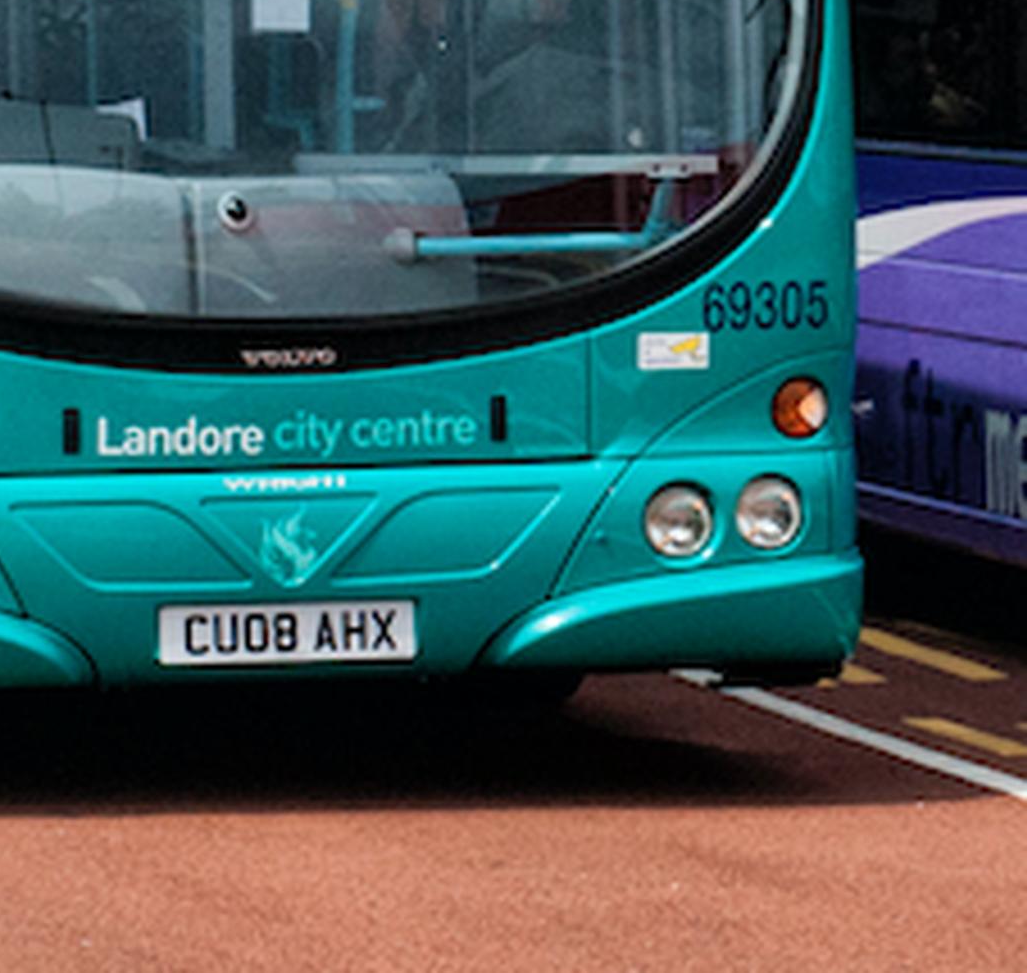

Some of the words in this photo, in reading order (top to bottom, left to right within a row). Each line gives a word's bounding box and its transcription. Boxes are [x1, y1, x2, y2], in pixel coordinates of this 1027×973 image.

[703, 280, 829, 333] 69305
[97, 417, 264, 456] Landore
[274, 411, 343, 458] city
[350, 410, 477, 448] centre
[184, 611, 298, 656] CU08
[313, 609, 396, 652] AHX
